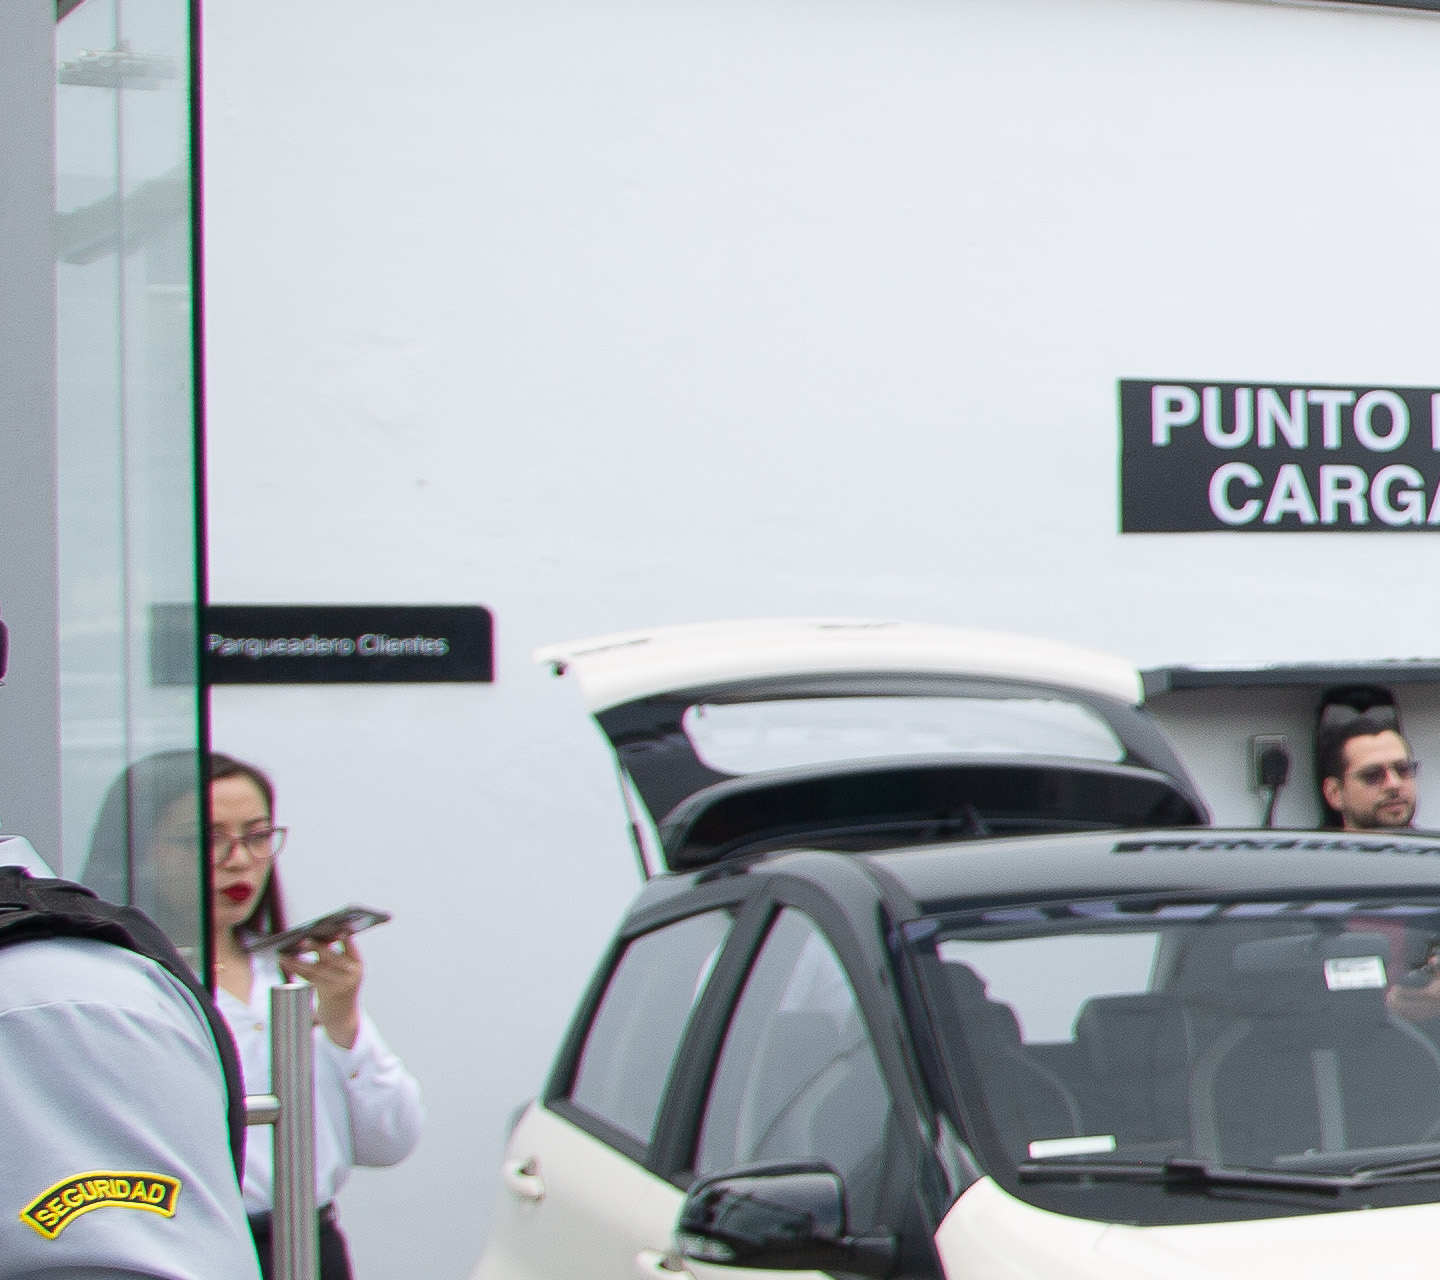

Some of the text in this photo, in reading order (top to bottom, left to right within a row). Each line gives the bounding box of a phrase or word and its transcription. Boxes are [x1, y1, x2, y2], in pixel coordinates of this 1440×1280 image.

[1151, 384, 1411, 452] PUNTO
[206, 633, 450, 660] Parqueadero Clientes
[35, 1178, 167, 1228] SEGURIDAD
